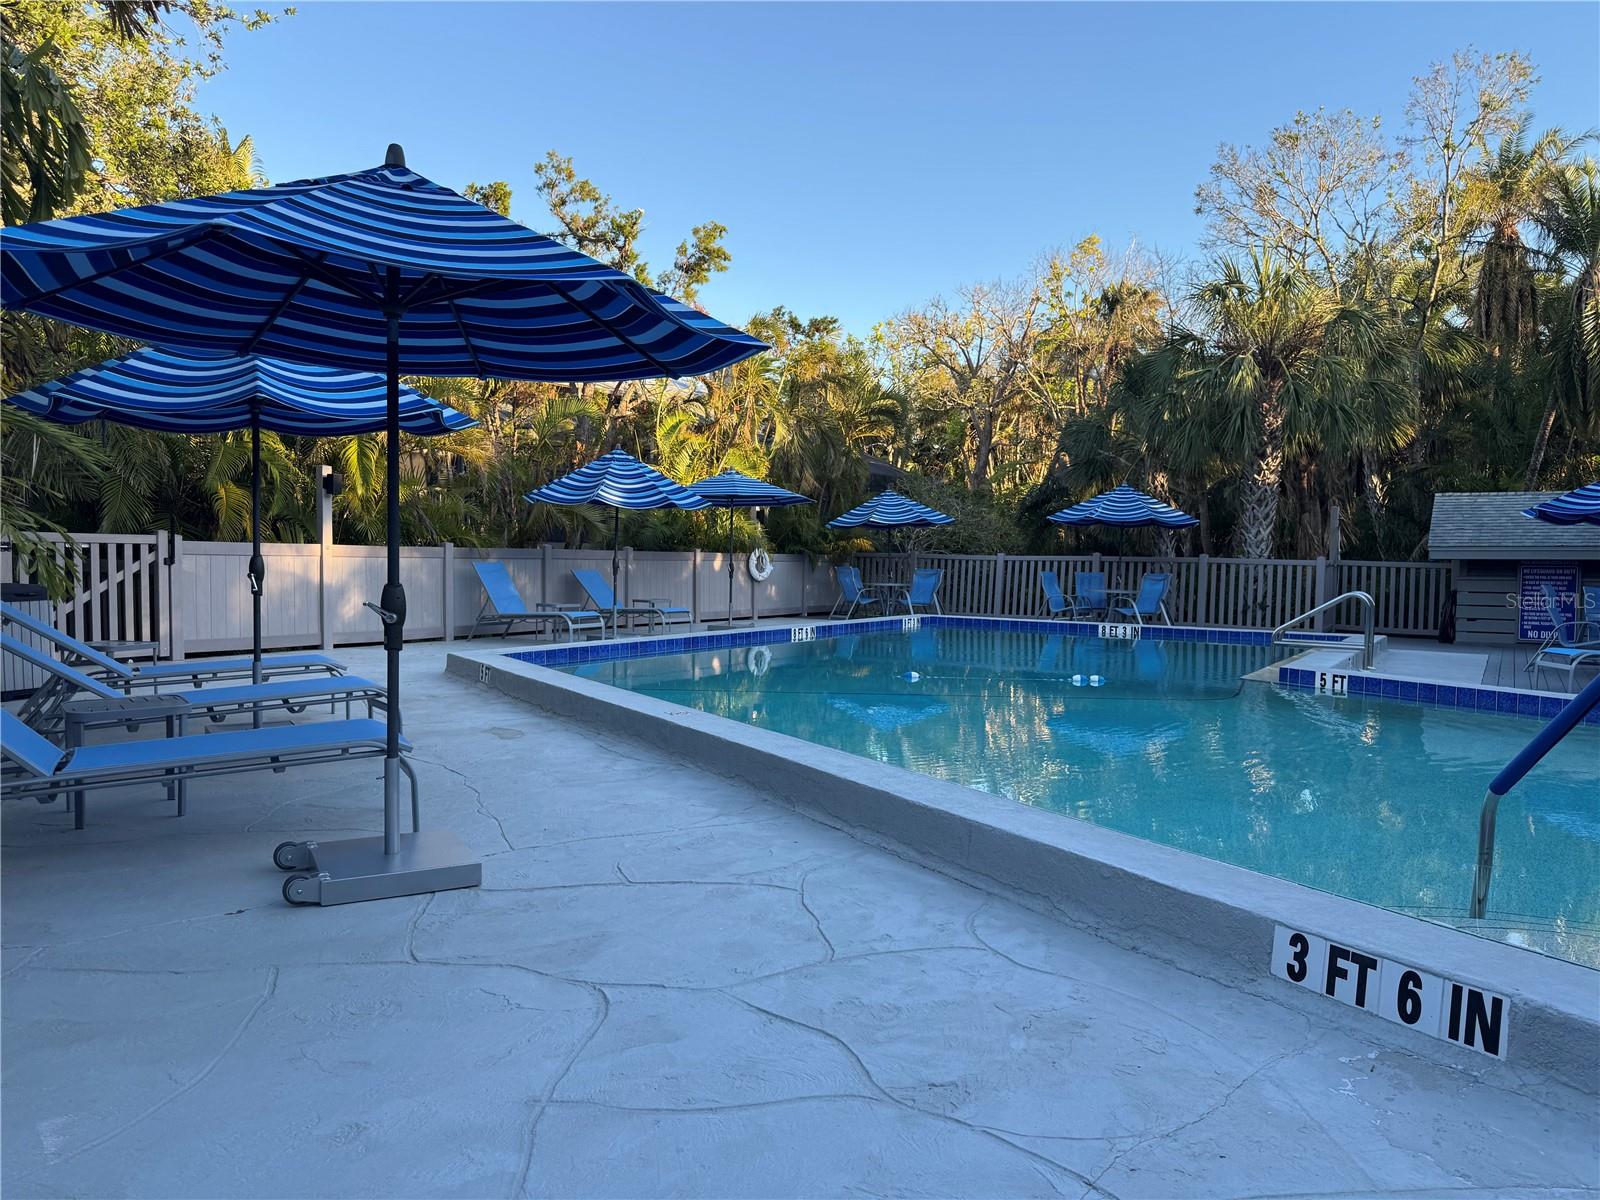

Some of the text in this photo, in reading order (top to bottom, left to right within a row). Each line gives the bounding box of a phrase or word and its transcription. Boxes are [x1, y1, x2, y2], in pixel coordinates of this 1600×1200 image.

[1130, 626, 1140, 639] IN
[1528, 630, 1538, 638] NO
[1320, 673, 1346, 690] 5 FT
[1286, 932, 1504, 1056] 3 FT 6 IN
